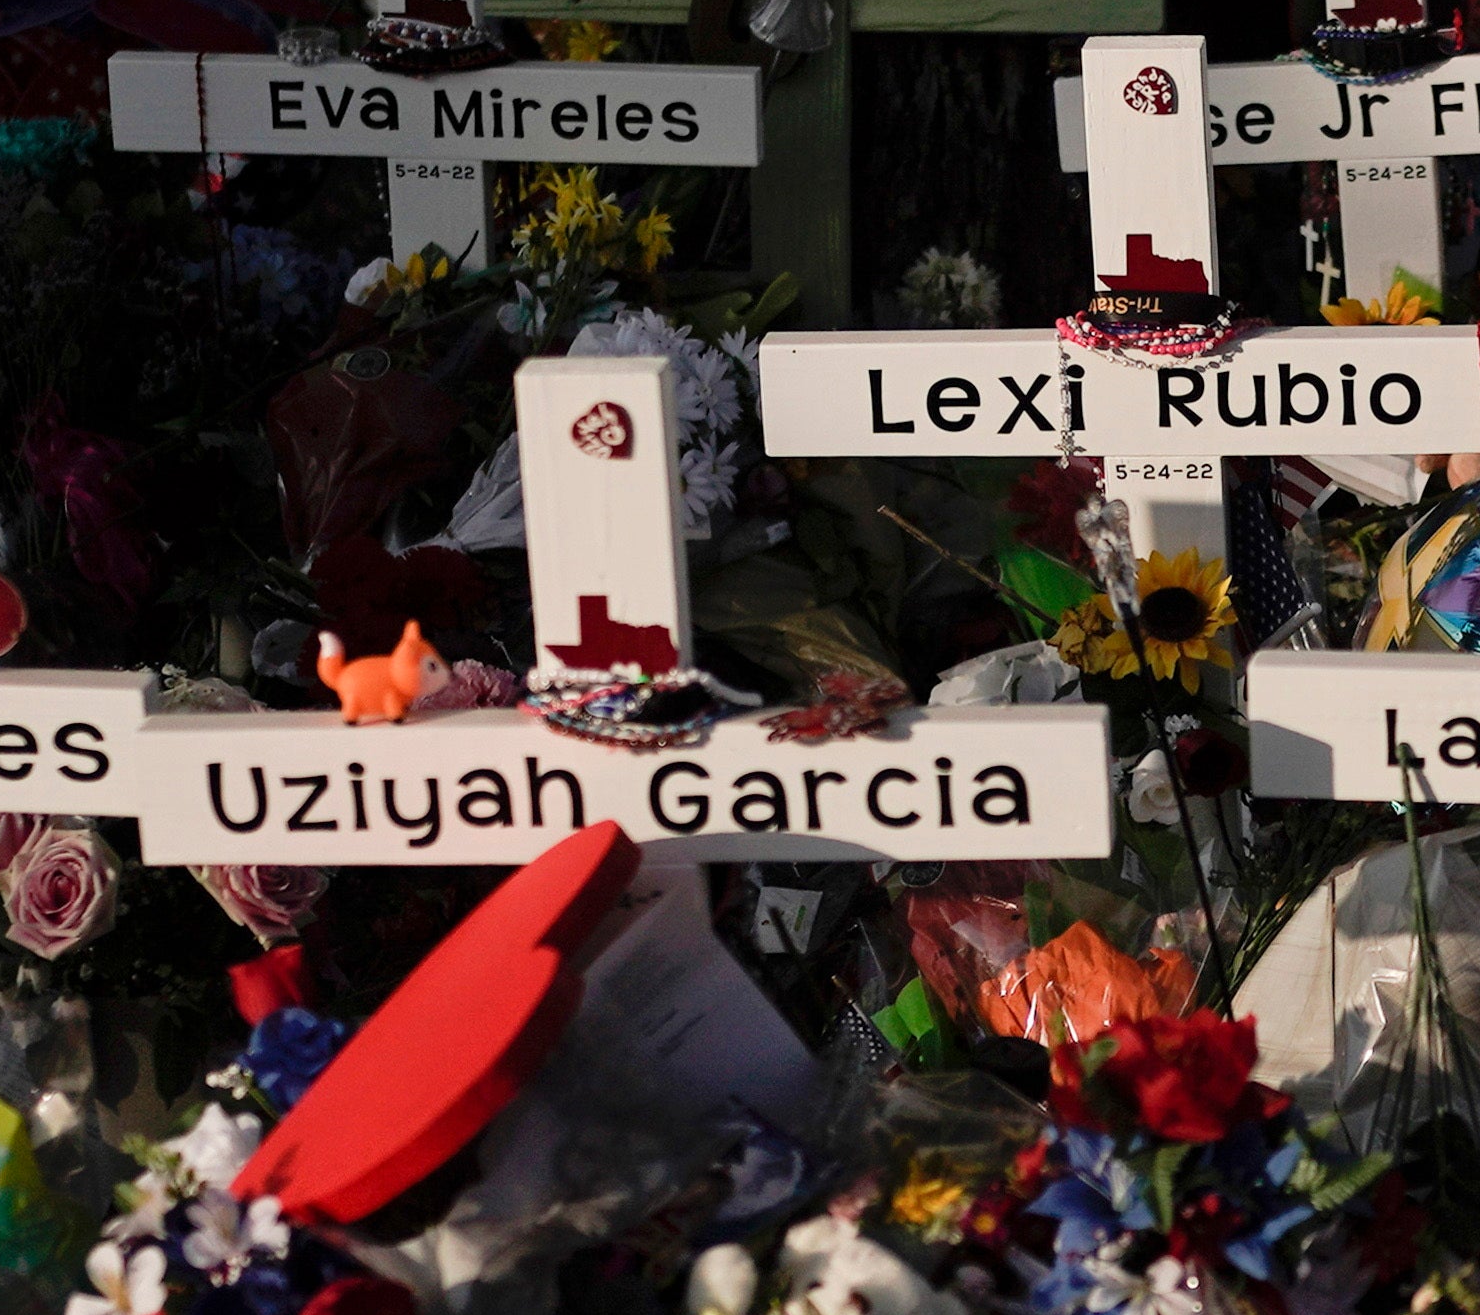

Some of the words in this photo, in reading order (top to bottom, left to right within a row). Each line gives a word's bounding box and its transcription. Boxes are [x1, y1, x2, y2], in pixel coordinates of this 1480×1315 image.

[269, 81, 399, 131] Eva
[434, 89, 699, 141] Mireles
[1320, 84, 1389, 138] Jr
[396, 164, 474, 179] 5-24-22
[1346, 165, 1426, 182] 5-24-22
[868, 369, 1084, 434] Lexi
[1158, 362, 1423, 427] Rubio
[1116, 464, 1212, 479] 5-24-22
[208, 757, 588, 846] Uziyah
[648, 757, 1030, 831] Garcia
